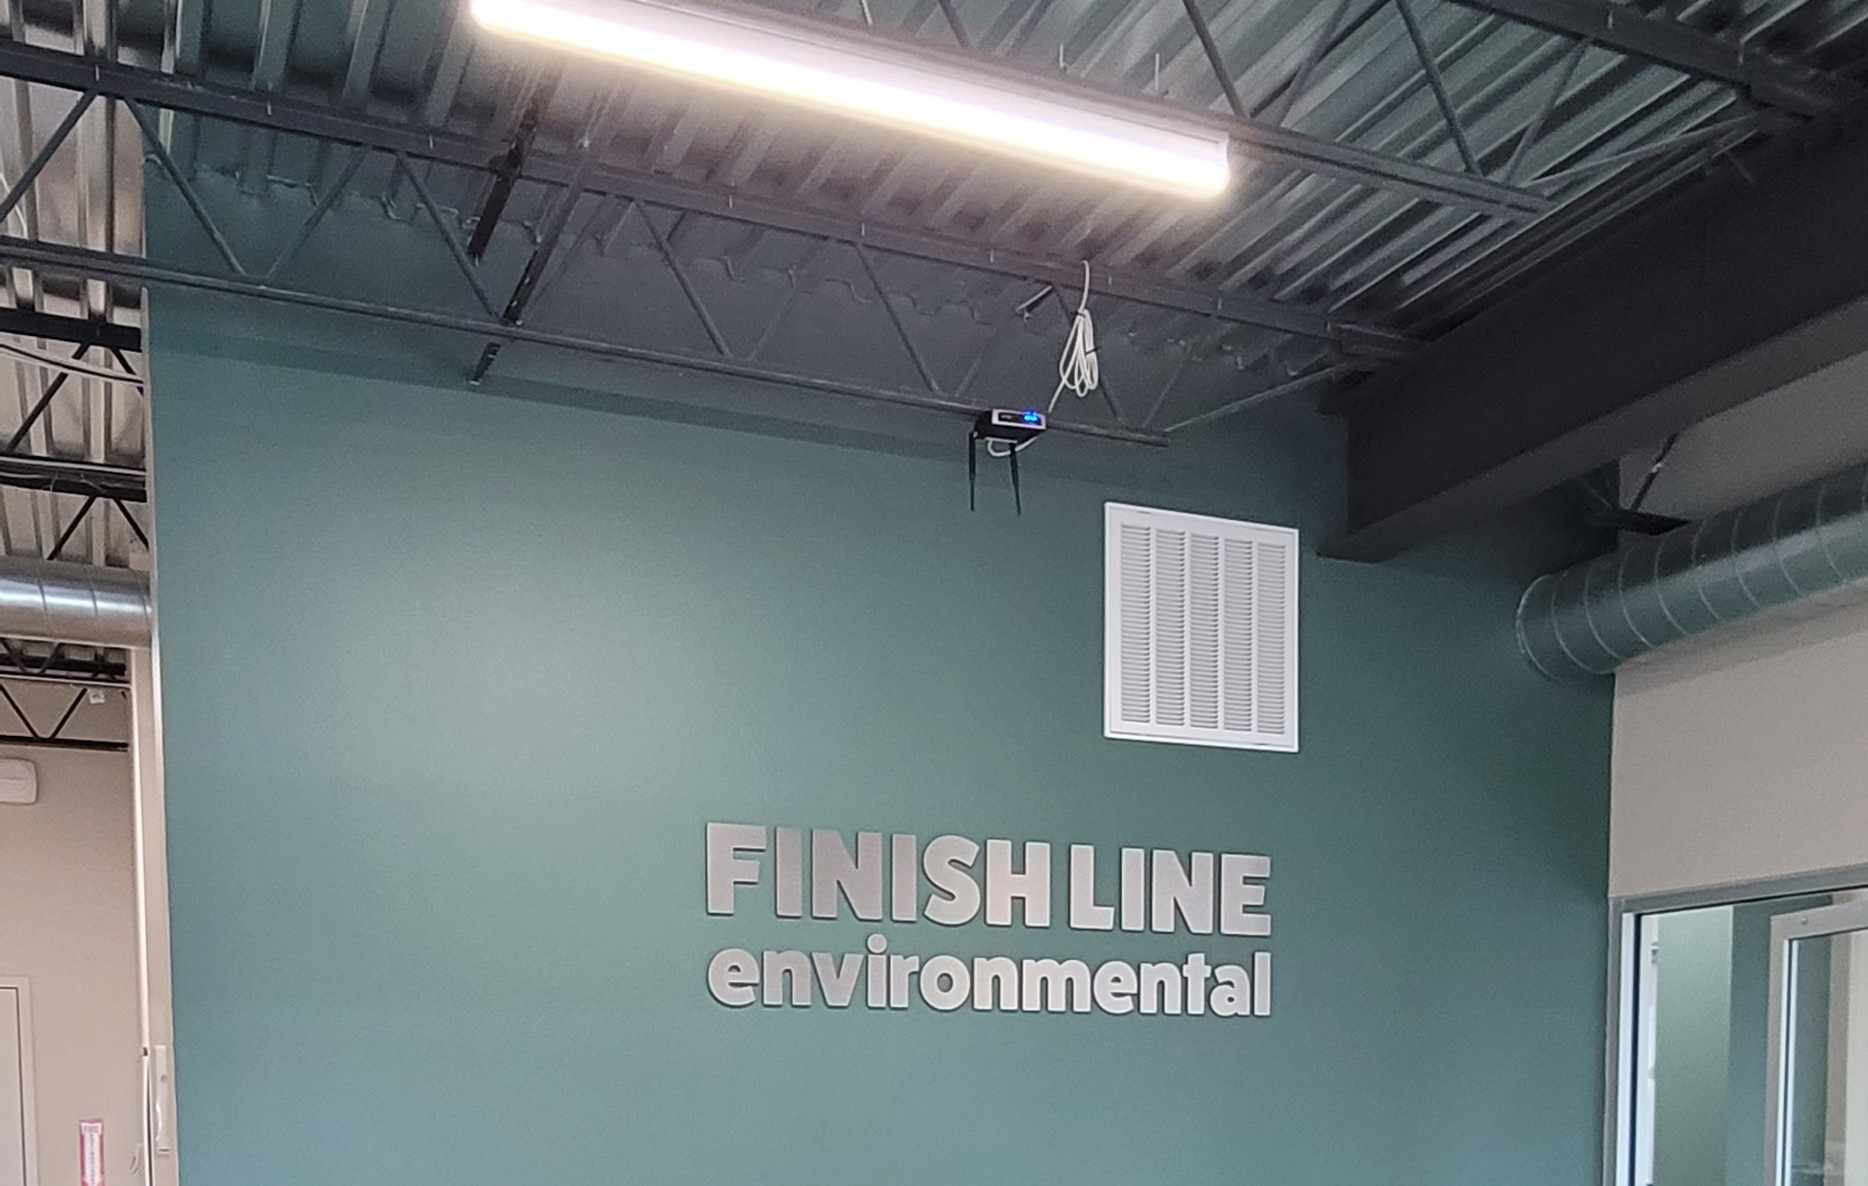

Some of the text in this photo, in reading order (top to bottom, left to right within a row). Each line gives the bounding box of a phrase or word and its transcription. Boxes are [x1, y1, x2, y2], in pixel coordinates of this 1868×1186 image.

[705, 822, 1272, 936] FINISH LINE
[707, 933, 1272, 1017] environmental
